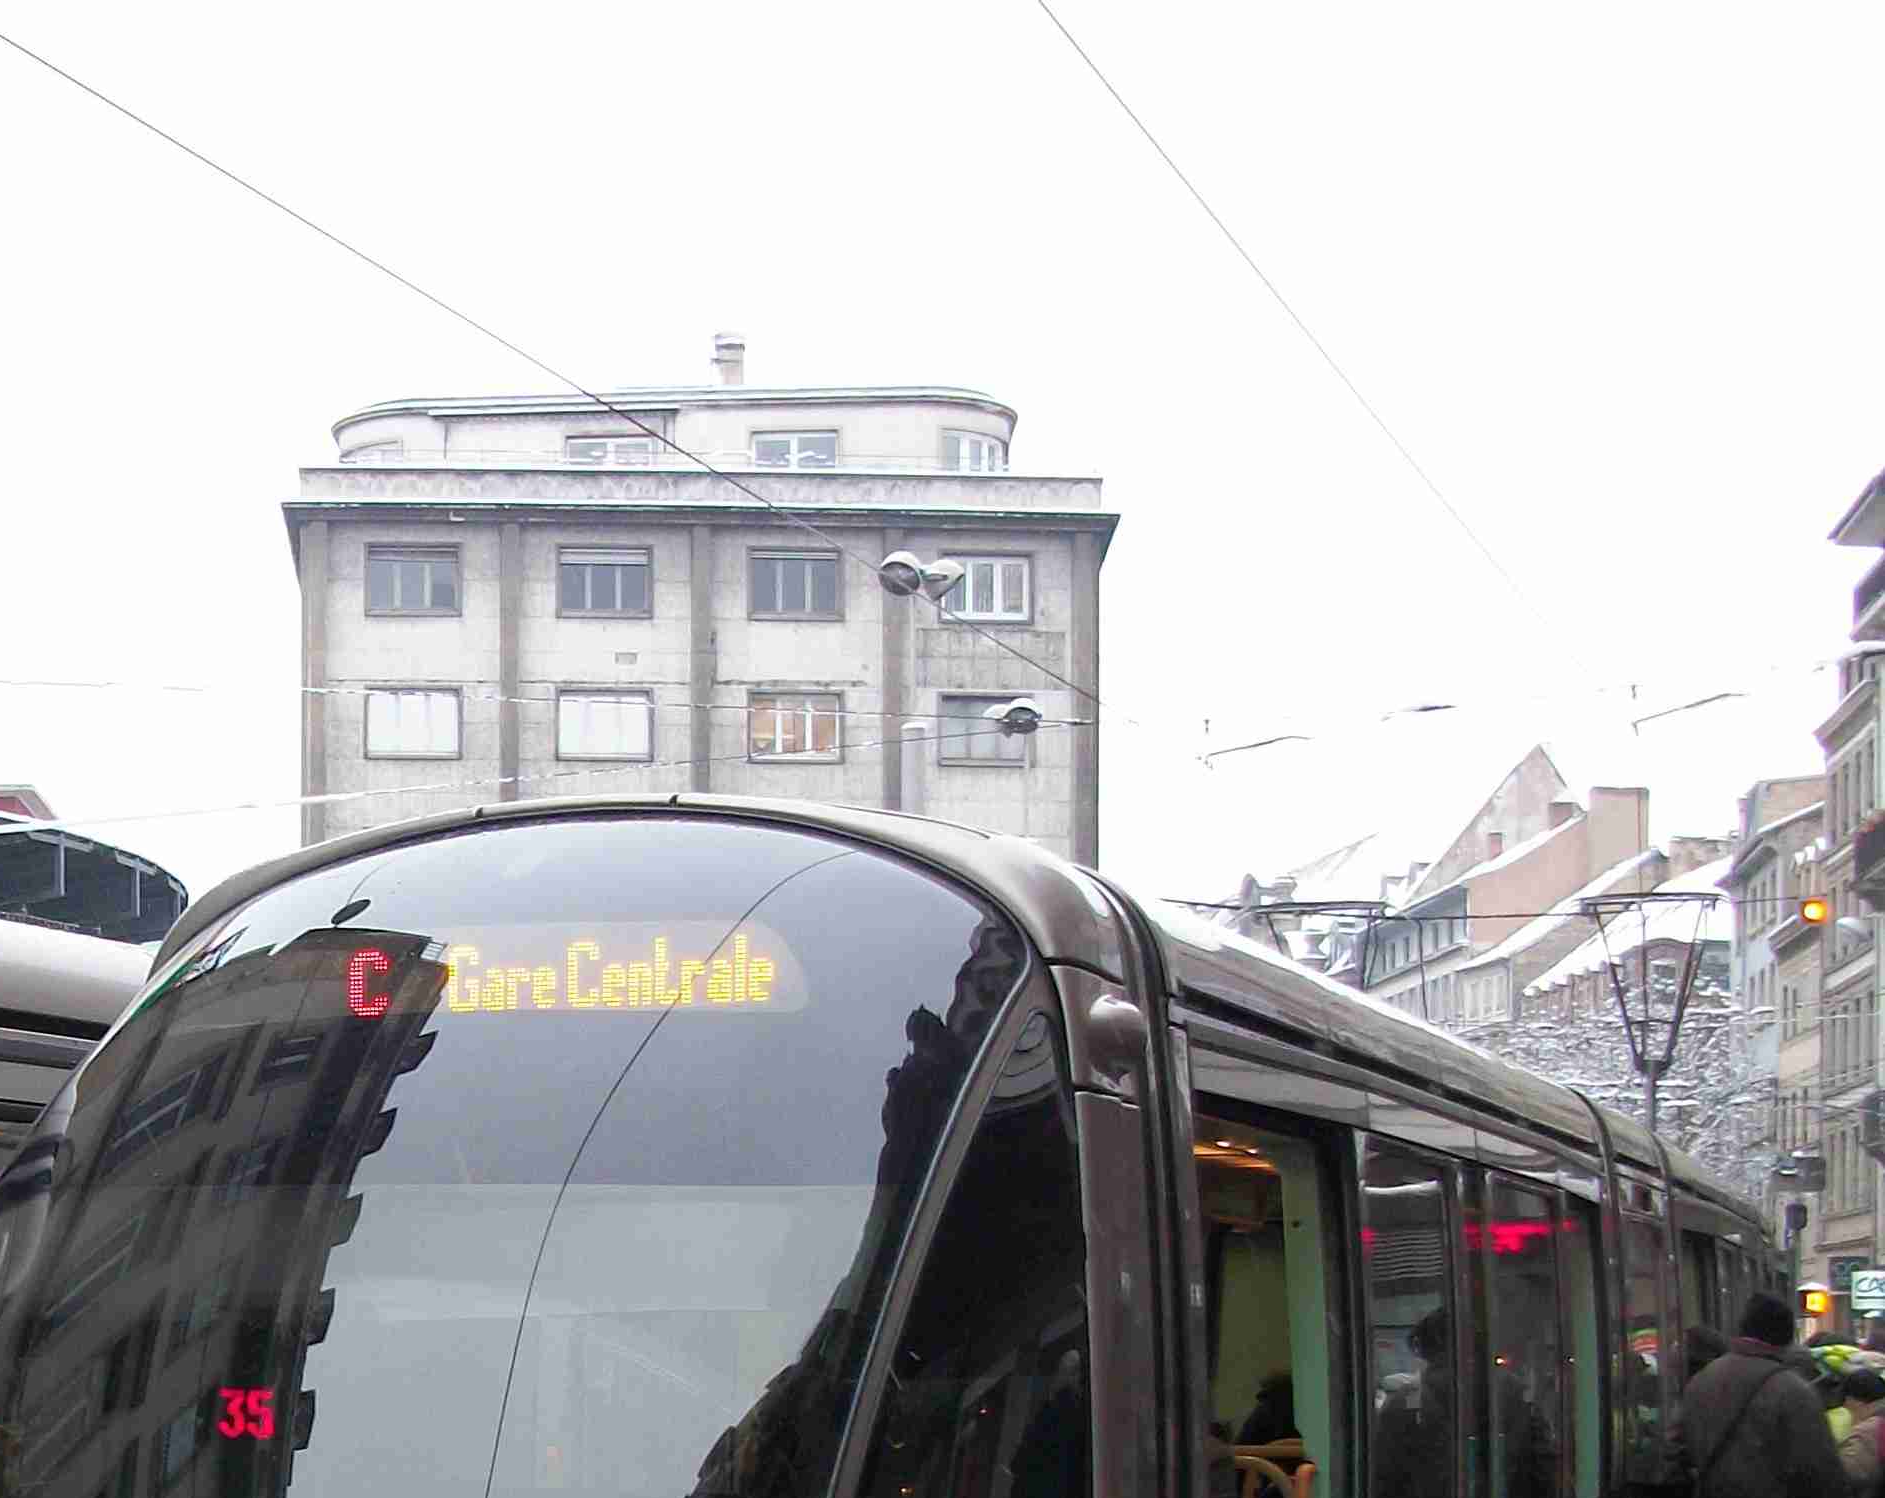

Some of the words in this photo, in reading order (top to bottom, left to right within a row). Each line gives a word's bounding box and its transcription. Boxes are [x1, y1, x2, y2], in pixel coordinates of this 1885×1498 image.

[348, 950, 390, 1018] C
[447, 945, 557, 1014] Gare
[565, 934, 774, 1009] Centrale
[217, 1386, 275, 1440] 35
